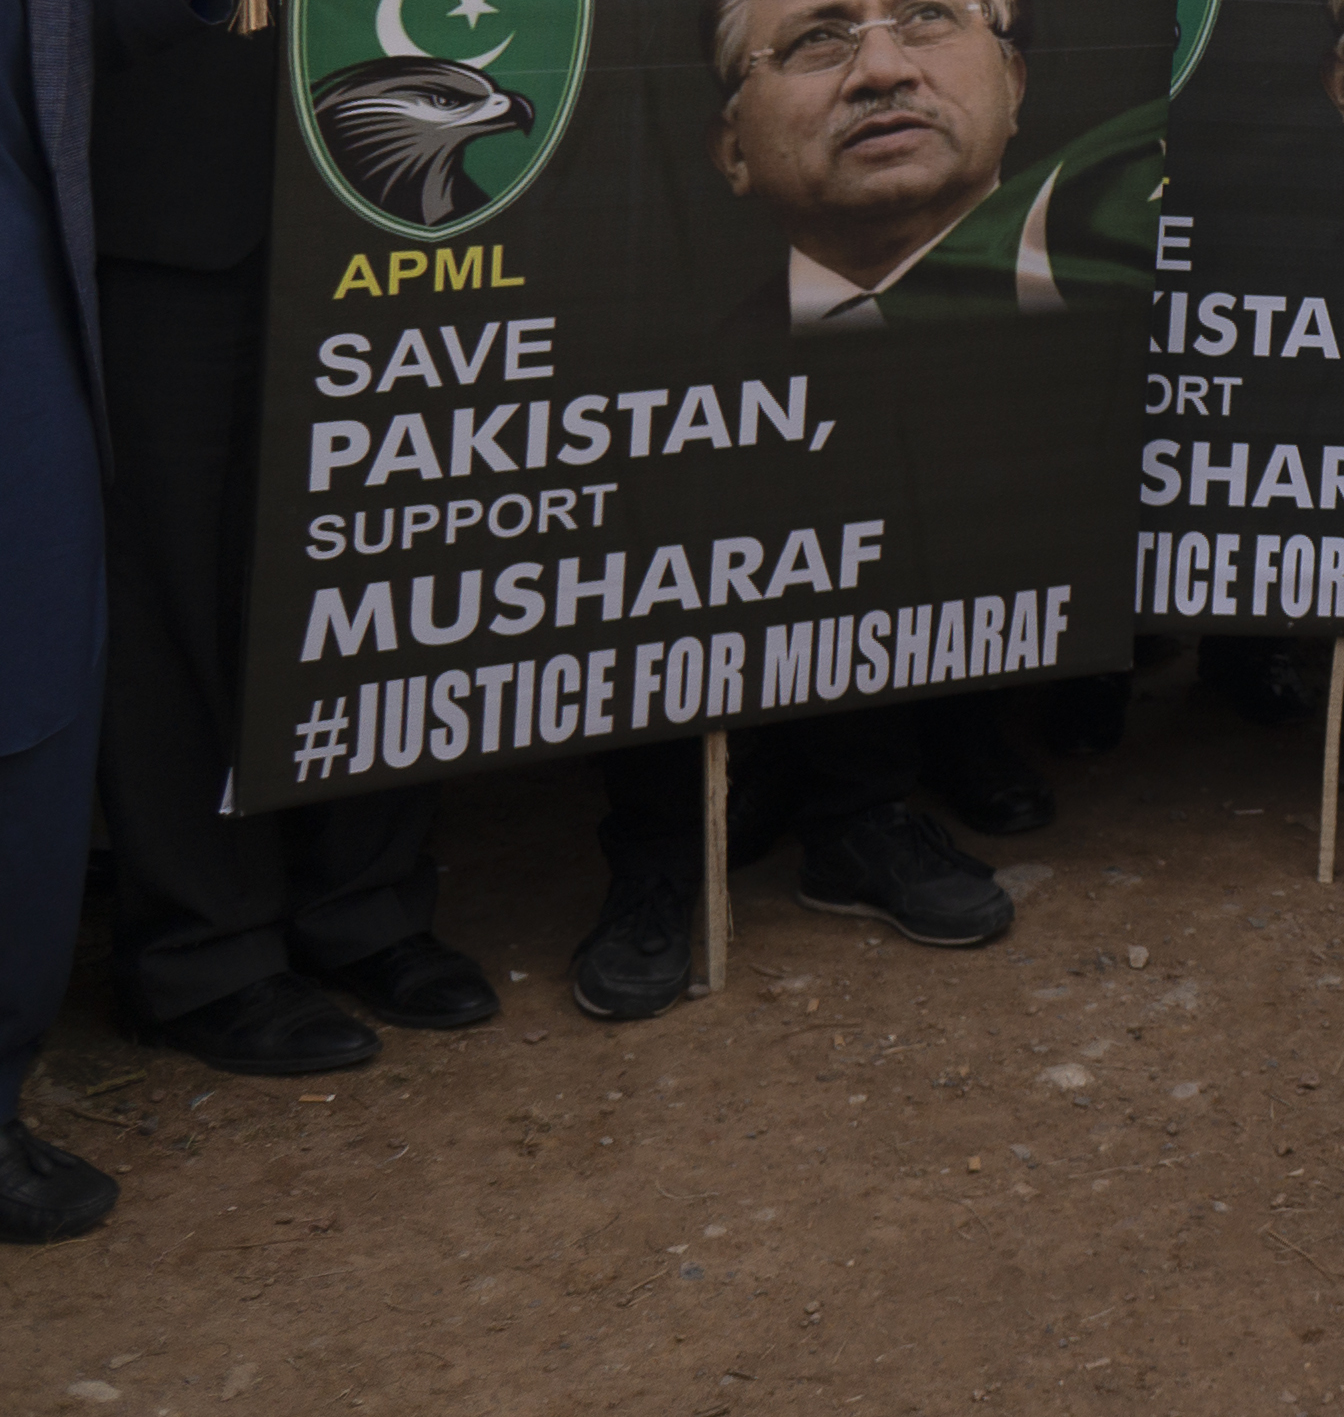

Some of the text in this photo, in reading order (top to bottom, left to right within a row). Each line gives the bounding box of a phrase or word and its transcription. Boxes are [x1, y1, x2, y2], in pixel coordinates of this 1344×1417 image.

[332, 244, 526, 301] APML
[314, 317, 557, 399] SAVE
[307, 376, 838, 493] PAKISTAN,
[304, 483, 619, 562] SUPPORT
[298, 519, 886, 664] MUSHARAF
[293, 585, 1072, 782] #JUSTICE FOR MUSHARAF
